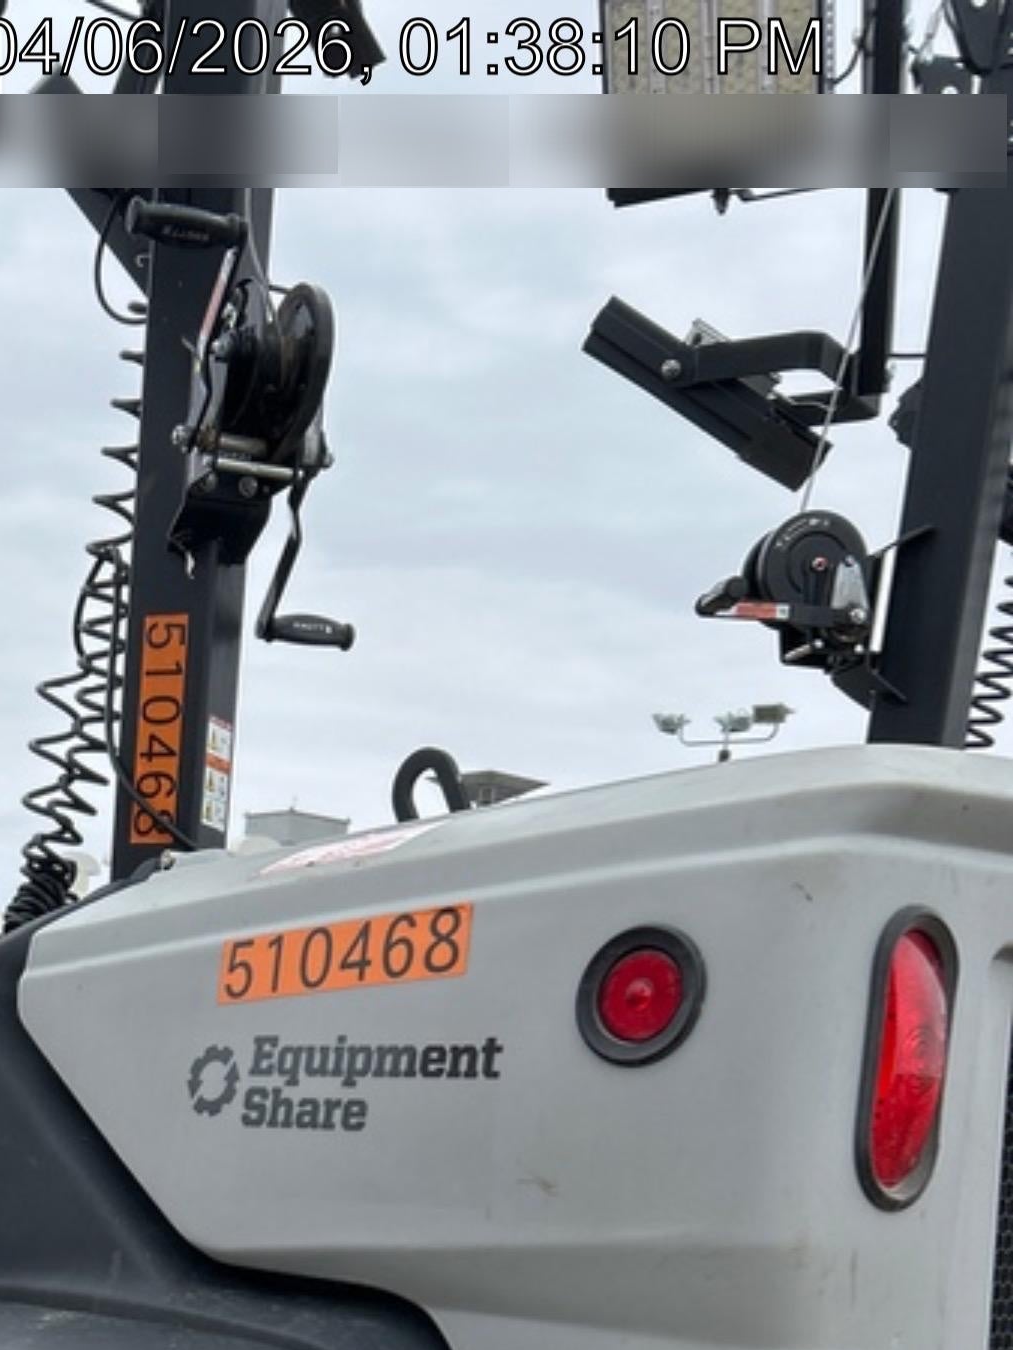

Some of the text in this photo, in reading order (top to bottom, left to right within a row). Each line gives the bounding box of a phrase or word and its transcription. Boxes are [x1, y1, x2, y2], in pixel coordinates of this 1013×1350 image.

[224, 906, 462, 1000] 510468
[248, 1034, 504, 1088] Equipment
[241, 1085, 368, 1132] Share
